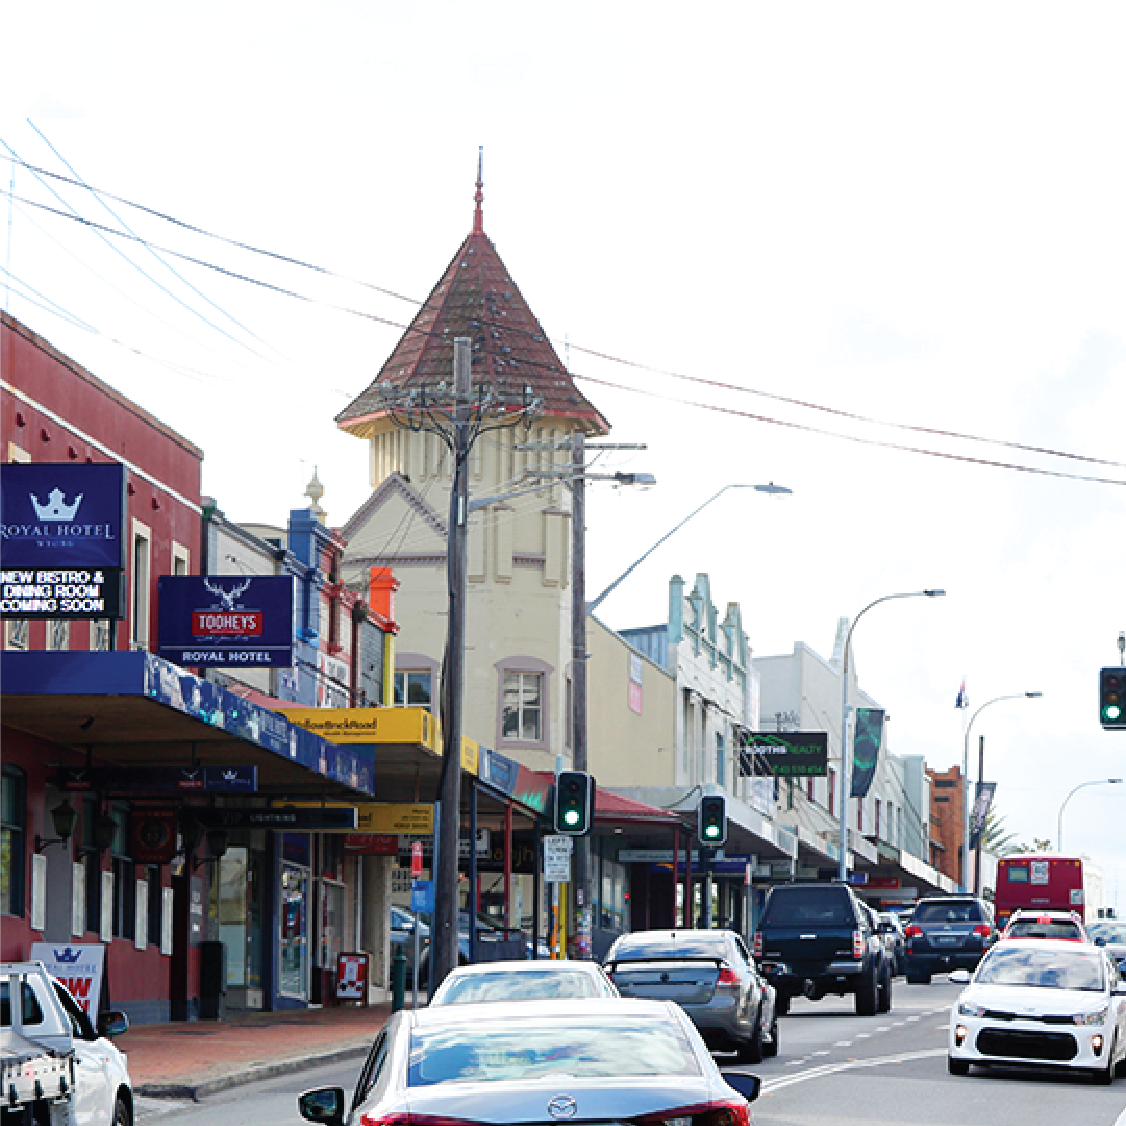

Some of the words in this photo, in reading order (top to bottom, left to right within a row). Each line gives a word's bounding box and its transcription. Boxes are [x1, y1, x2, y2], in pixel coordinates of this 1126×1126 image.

[57, 523, 115, 539] HOTEL
[35, 570, 91, 584] BISTRO
[92, 570, 105, 584] &
[3, 585, 53, 598] DINING
[54, 585, 101, 598] ROOM
[0, 600, 58, 612] COMING
[59, 600, 105, 612] SOON
[198, 614, 257, 630] TOOHEYS
[182, 651, 225, 661] ROYAL
[228, 651, 272, 661] HOTEL
